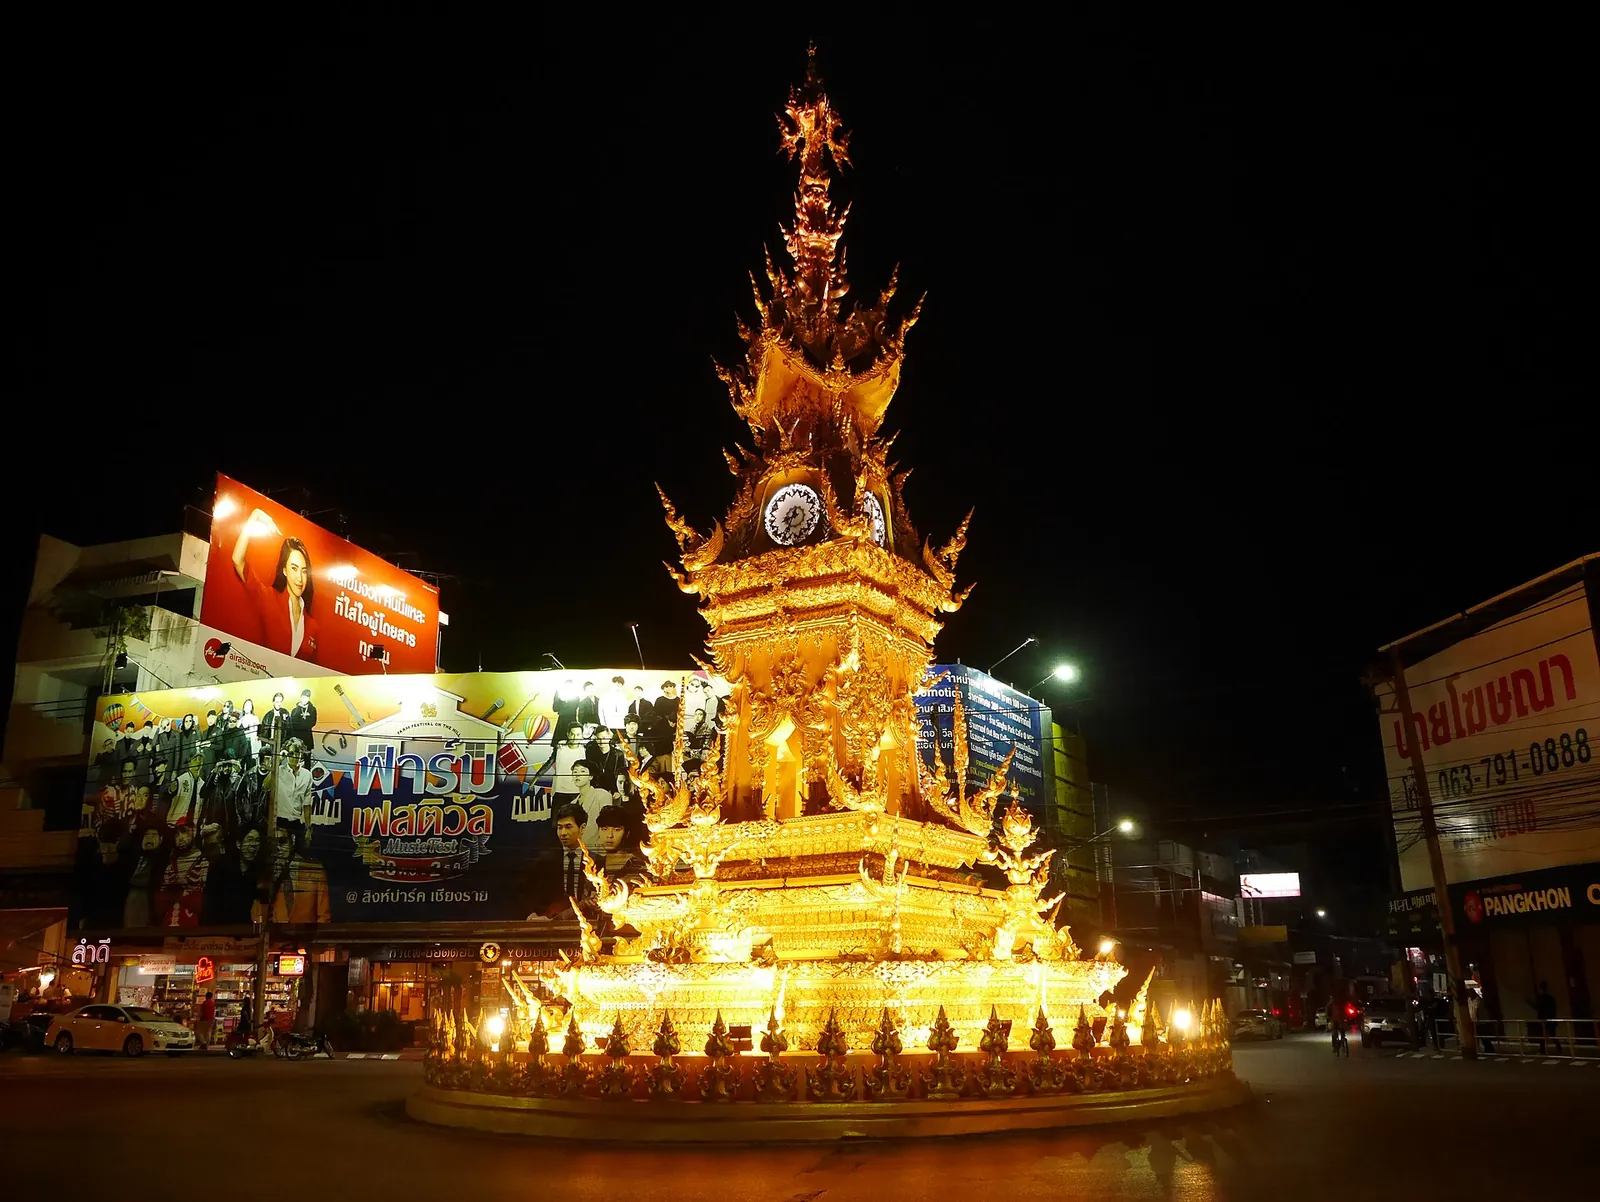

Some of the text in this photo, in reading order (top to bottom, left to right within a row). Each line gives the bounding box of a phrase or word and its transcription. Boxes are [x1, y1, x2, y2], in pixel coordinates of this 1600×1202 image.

[411, 721, 434, 729] FESTIVAL
[356, 737, 497, 796] ฟาร์ม
[1438, 727, 1592, 801] 063-791-0888
[351, 791, 494, 837] เฟสติวัล
[430, 888, 489, 903] เชียงราย
[1484, 886, 1573, 917] PANGKHON
